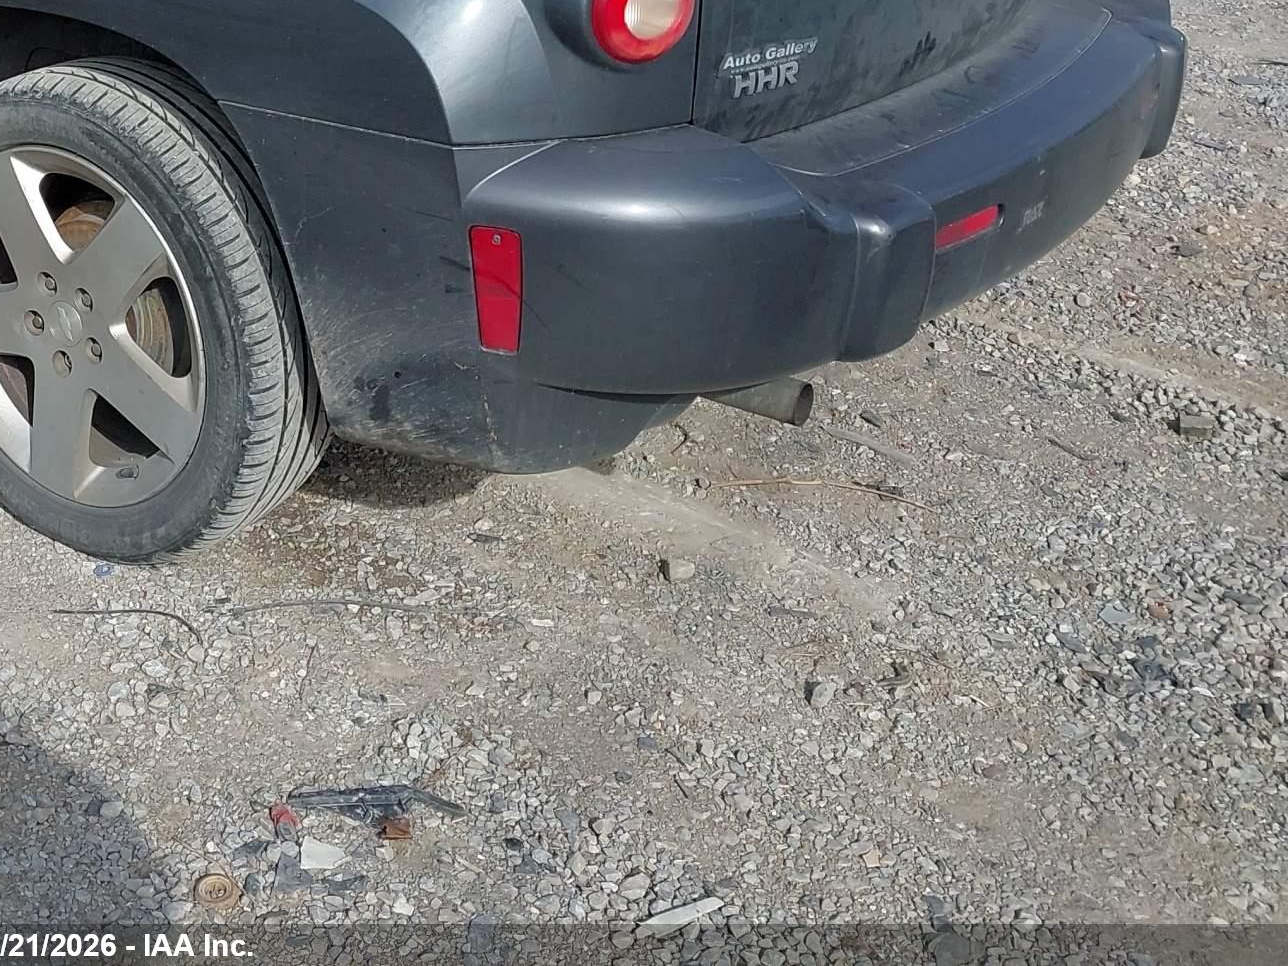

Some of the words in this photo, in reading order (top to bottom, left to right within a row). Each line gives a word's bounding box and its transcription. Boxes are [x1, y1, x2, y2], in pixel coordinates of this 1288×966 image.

[723, 52, 761, 70] Auto
[765, 39, 818, 60] Gallery
[732, 60, 800, 99] HHR
